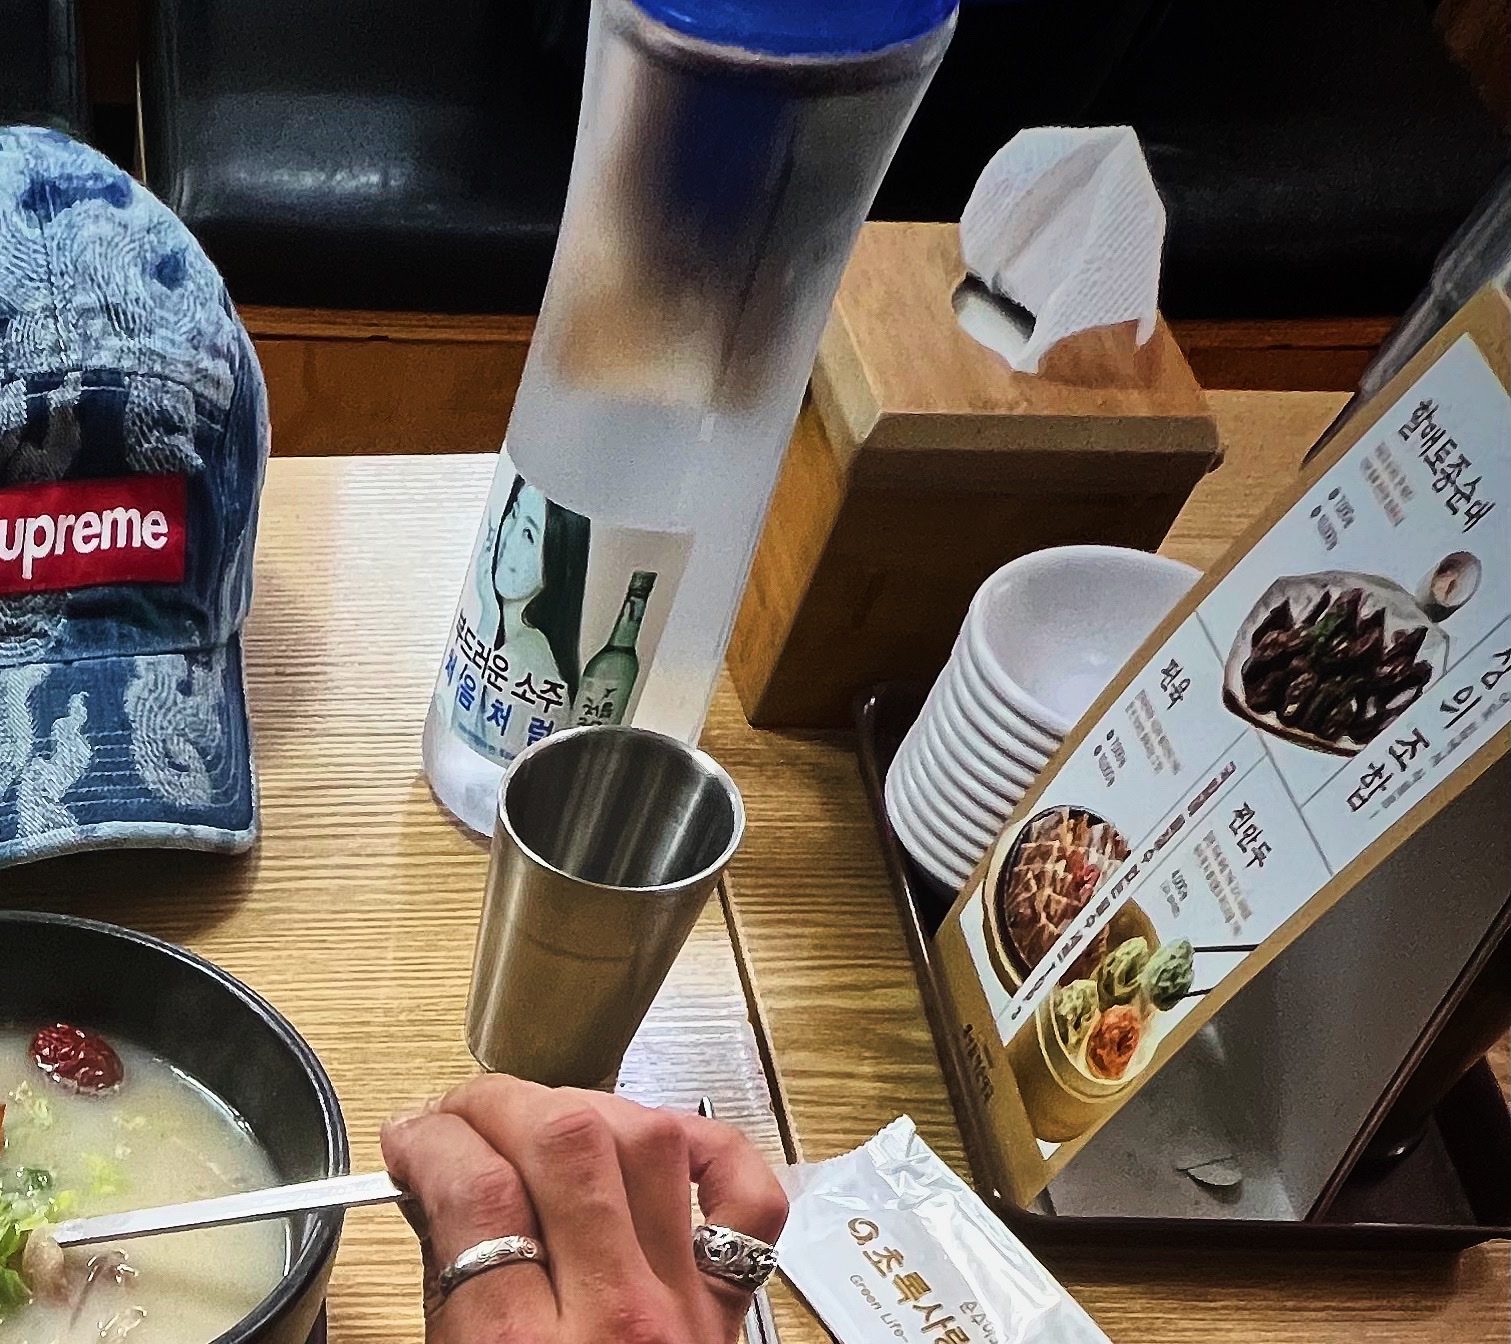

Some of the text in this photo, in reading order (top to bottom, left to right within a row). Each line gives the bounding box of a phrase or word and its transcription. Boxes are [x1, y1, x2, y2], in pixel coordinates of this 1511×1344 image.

[455, 608, 565, 713] 부드러운 소주
[1347, 727, 1431, 813] 조합
[1228, 801, 1274, 870] 찐만두
[849, 1274, 882, 1311] Green
